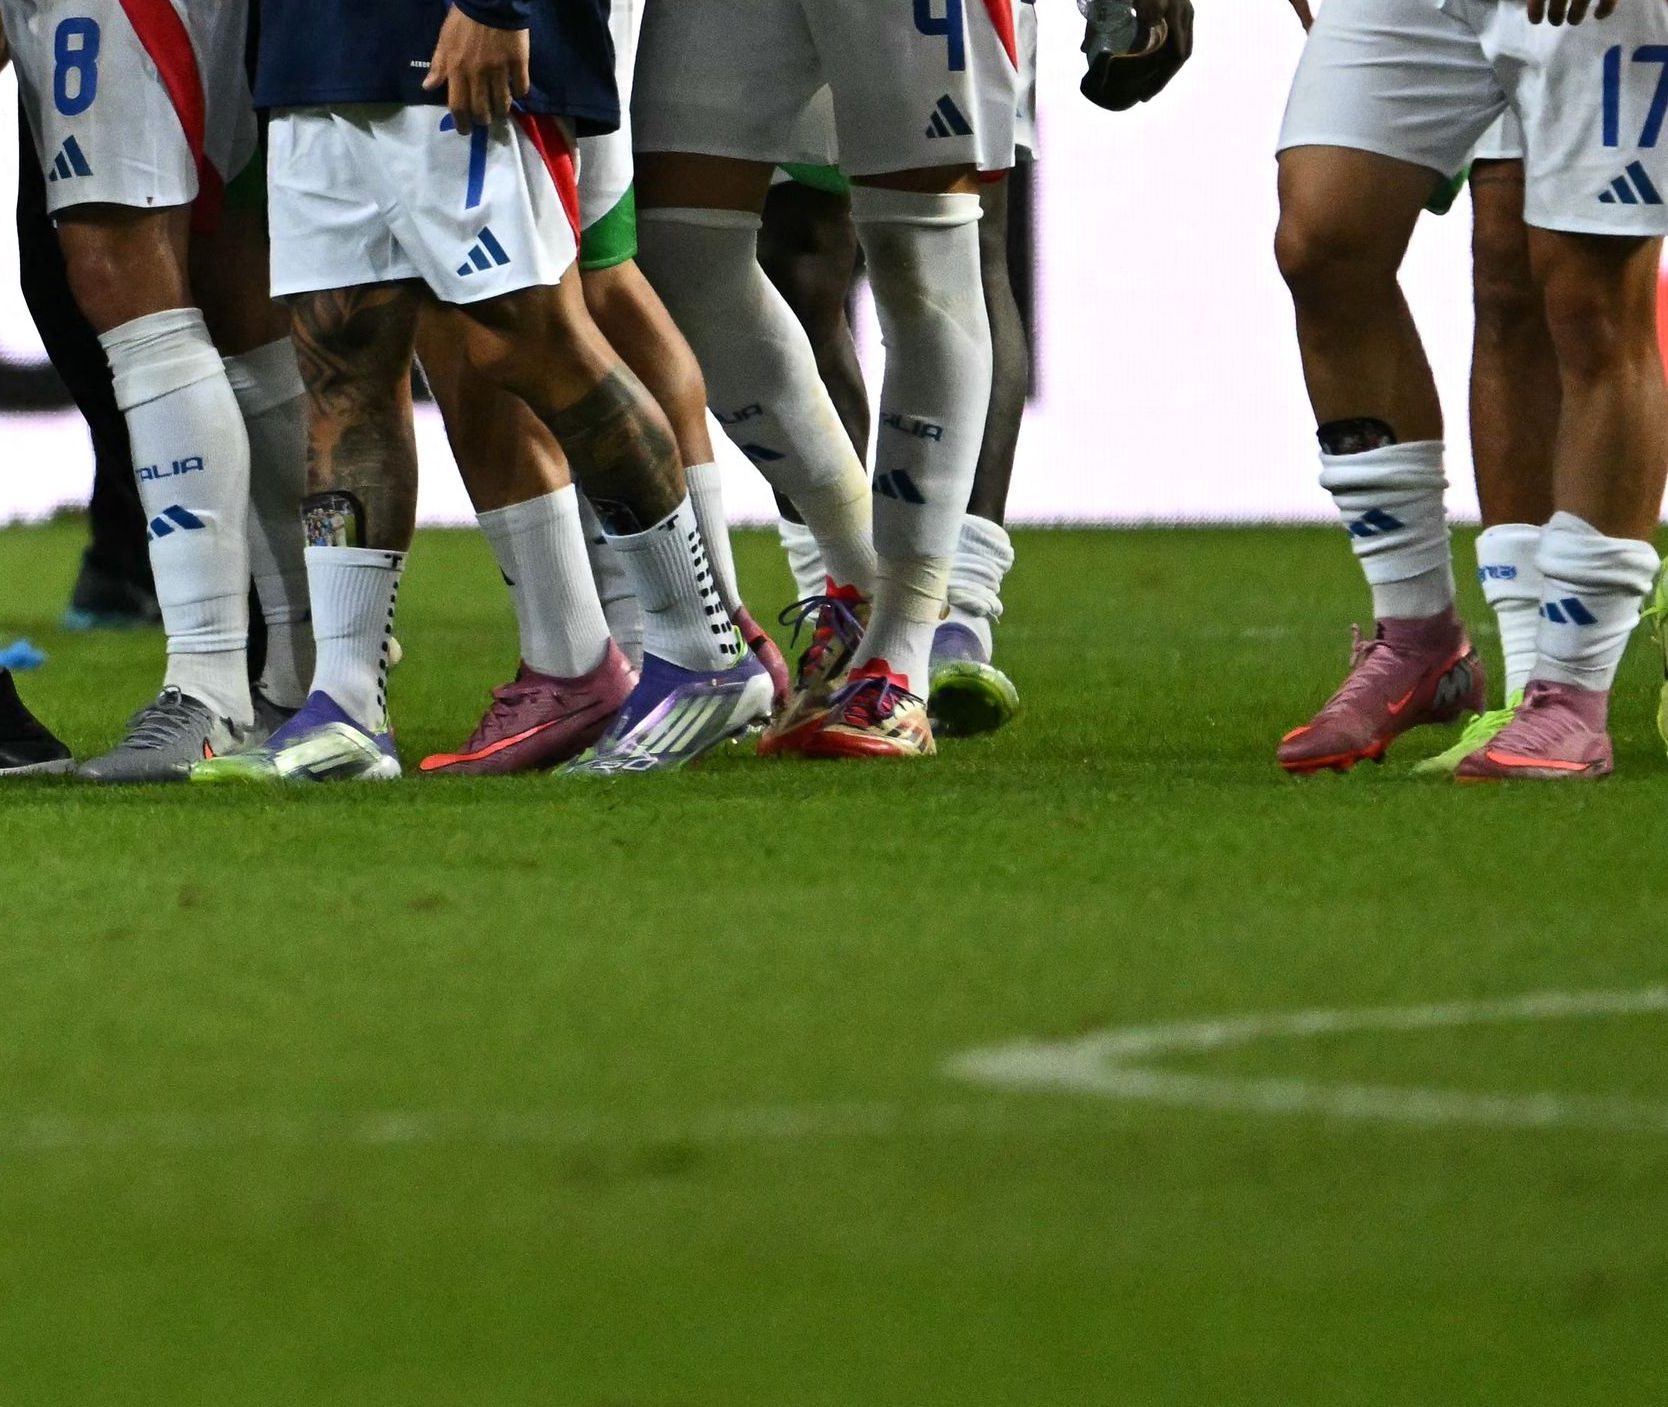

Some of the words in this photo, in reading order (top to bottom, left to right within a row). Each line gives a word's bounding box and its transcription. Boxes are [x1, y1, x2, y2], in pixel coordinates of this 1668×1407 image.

[53, 17, 101, 116] 8
[1603, 45, 1668, 148] 17
[136, 457, 204, 481] ALIA
